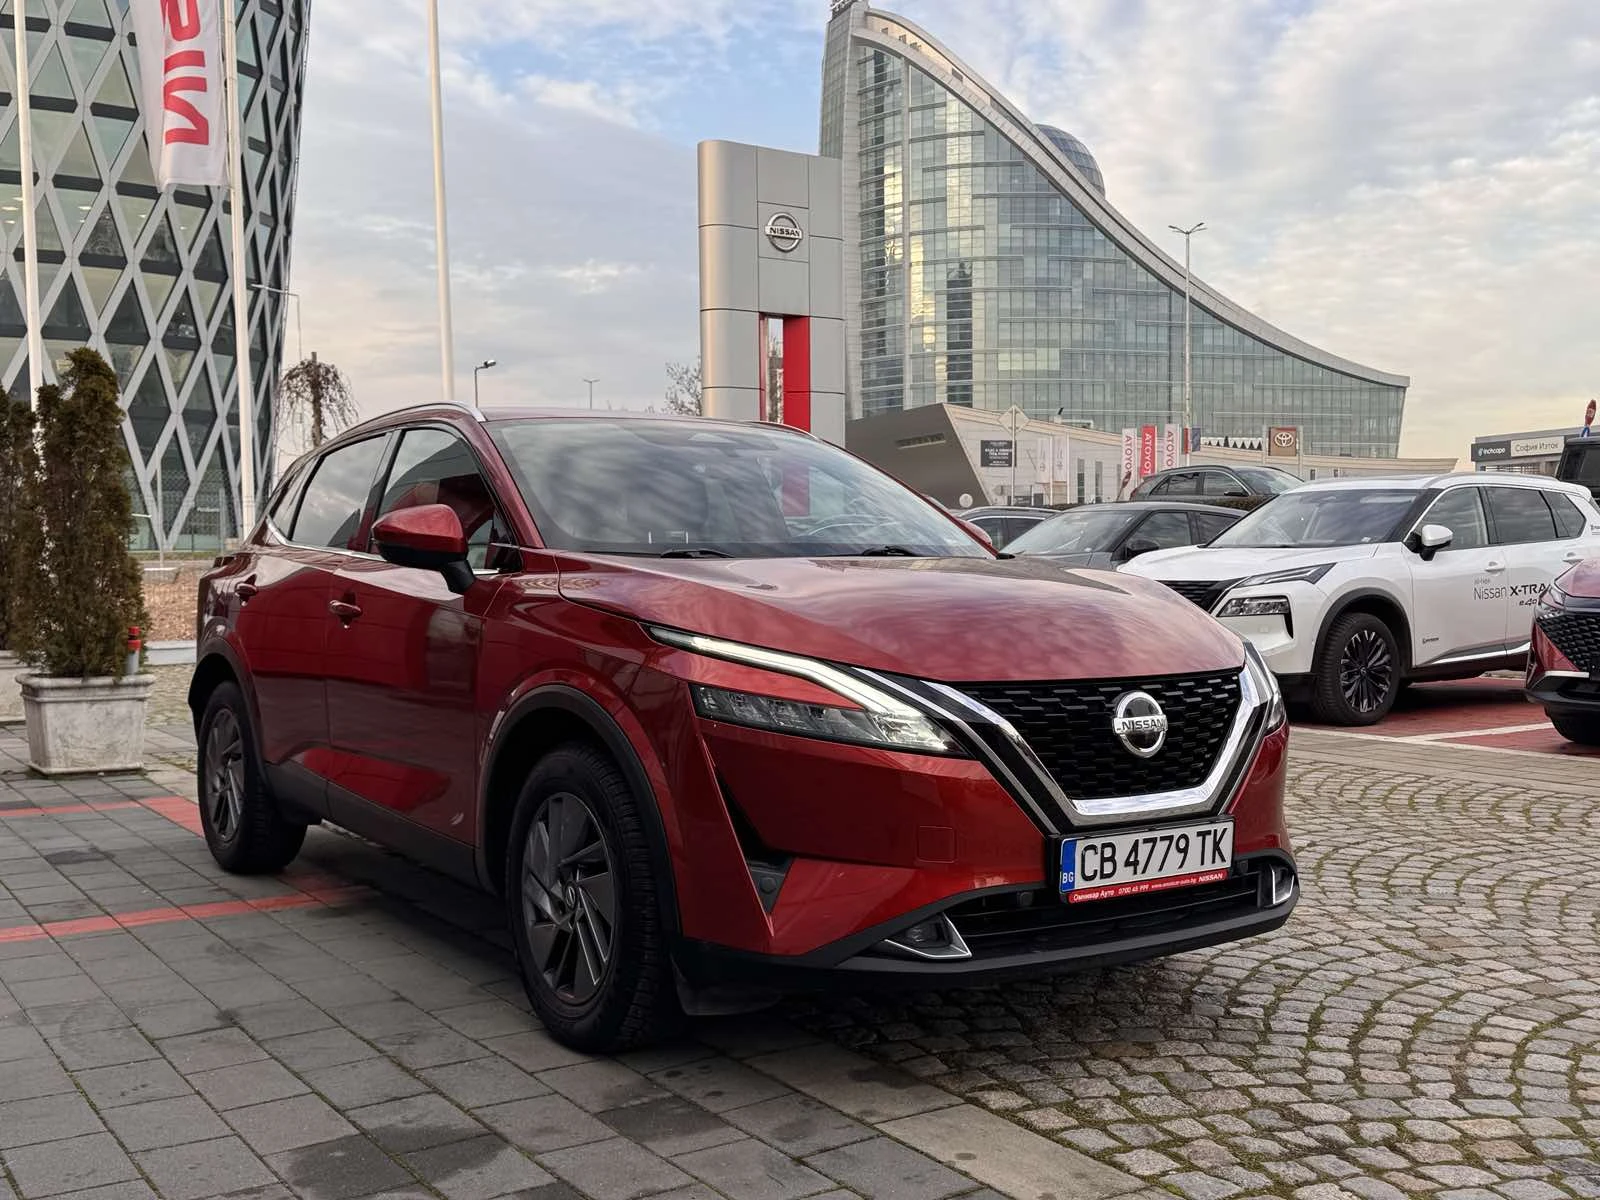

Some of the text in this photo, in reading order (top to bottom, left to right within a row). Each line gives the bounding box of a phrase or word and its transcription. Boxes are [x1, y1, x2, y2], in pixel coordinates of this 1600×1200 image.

[769, 227, 800, 237] NISSAN
[1473, 585, 1507, 600] Nissan
[1122, 719, 1165, 731] NISSAN
[1081, 827, 1228, 881] CB 4779 TK
[1062, 871, 1074, 884] BG
[1198, 873, 1223, 882] NISSAN
